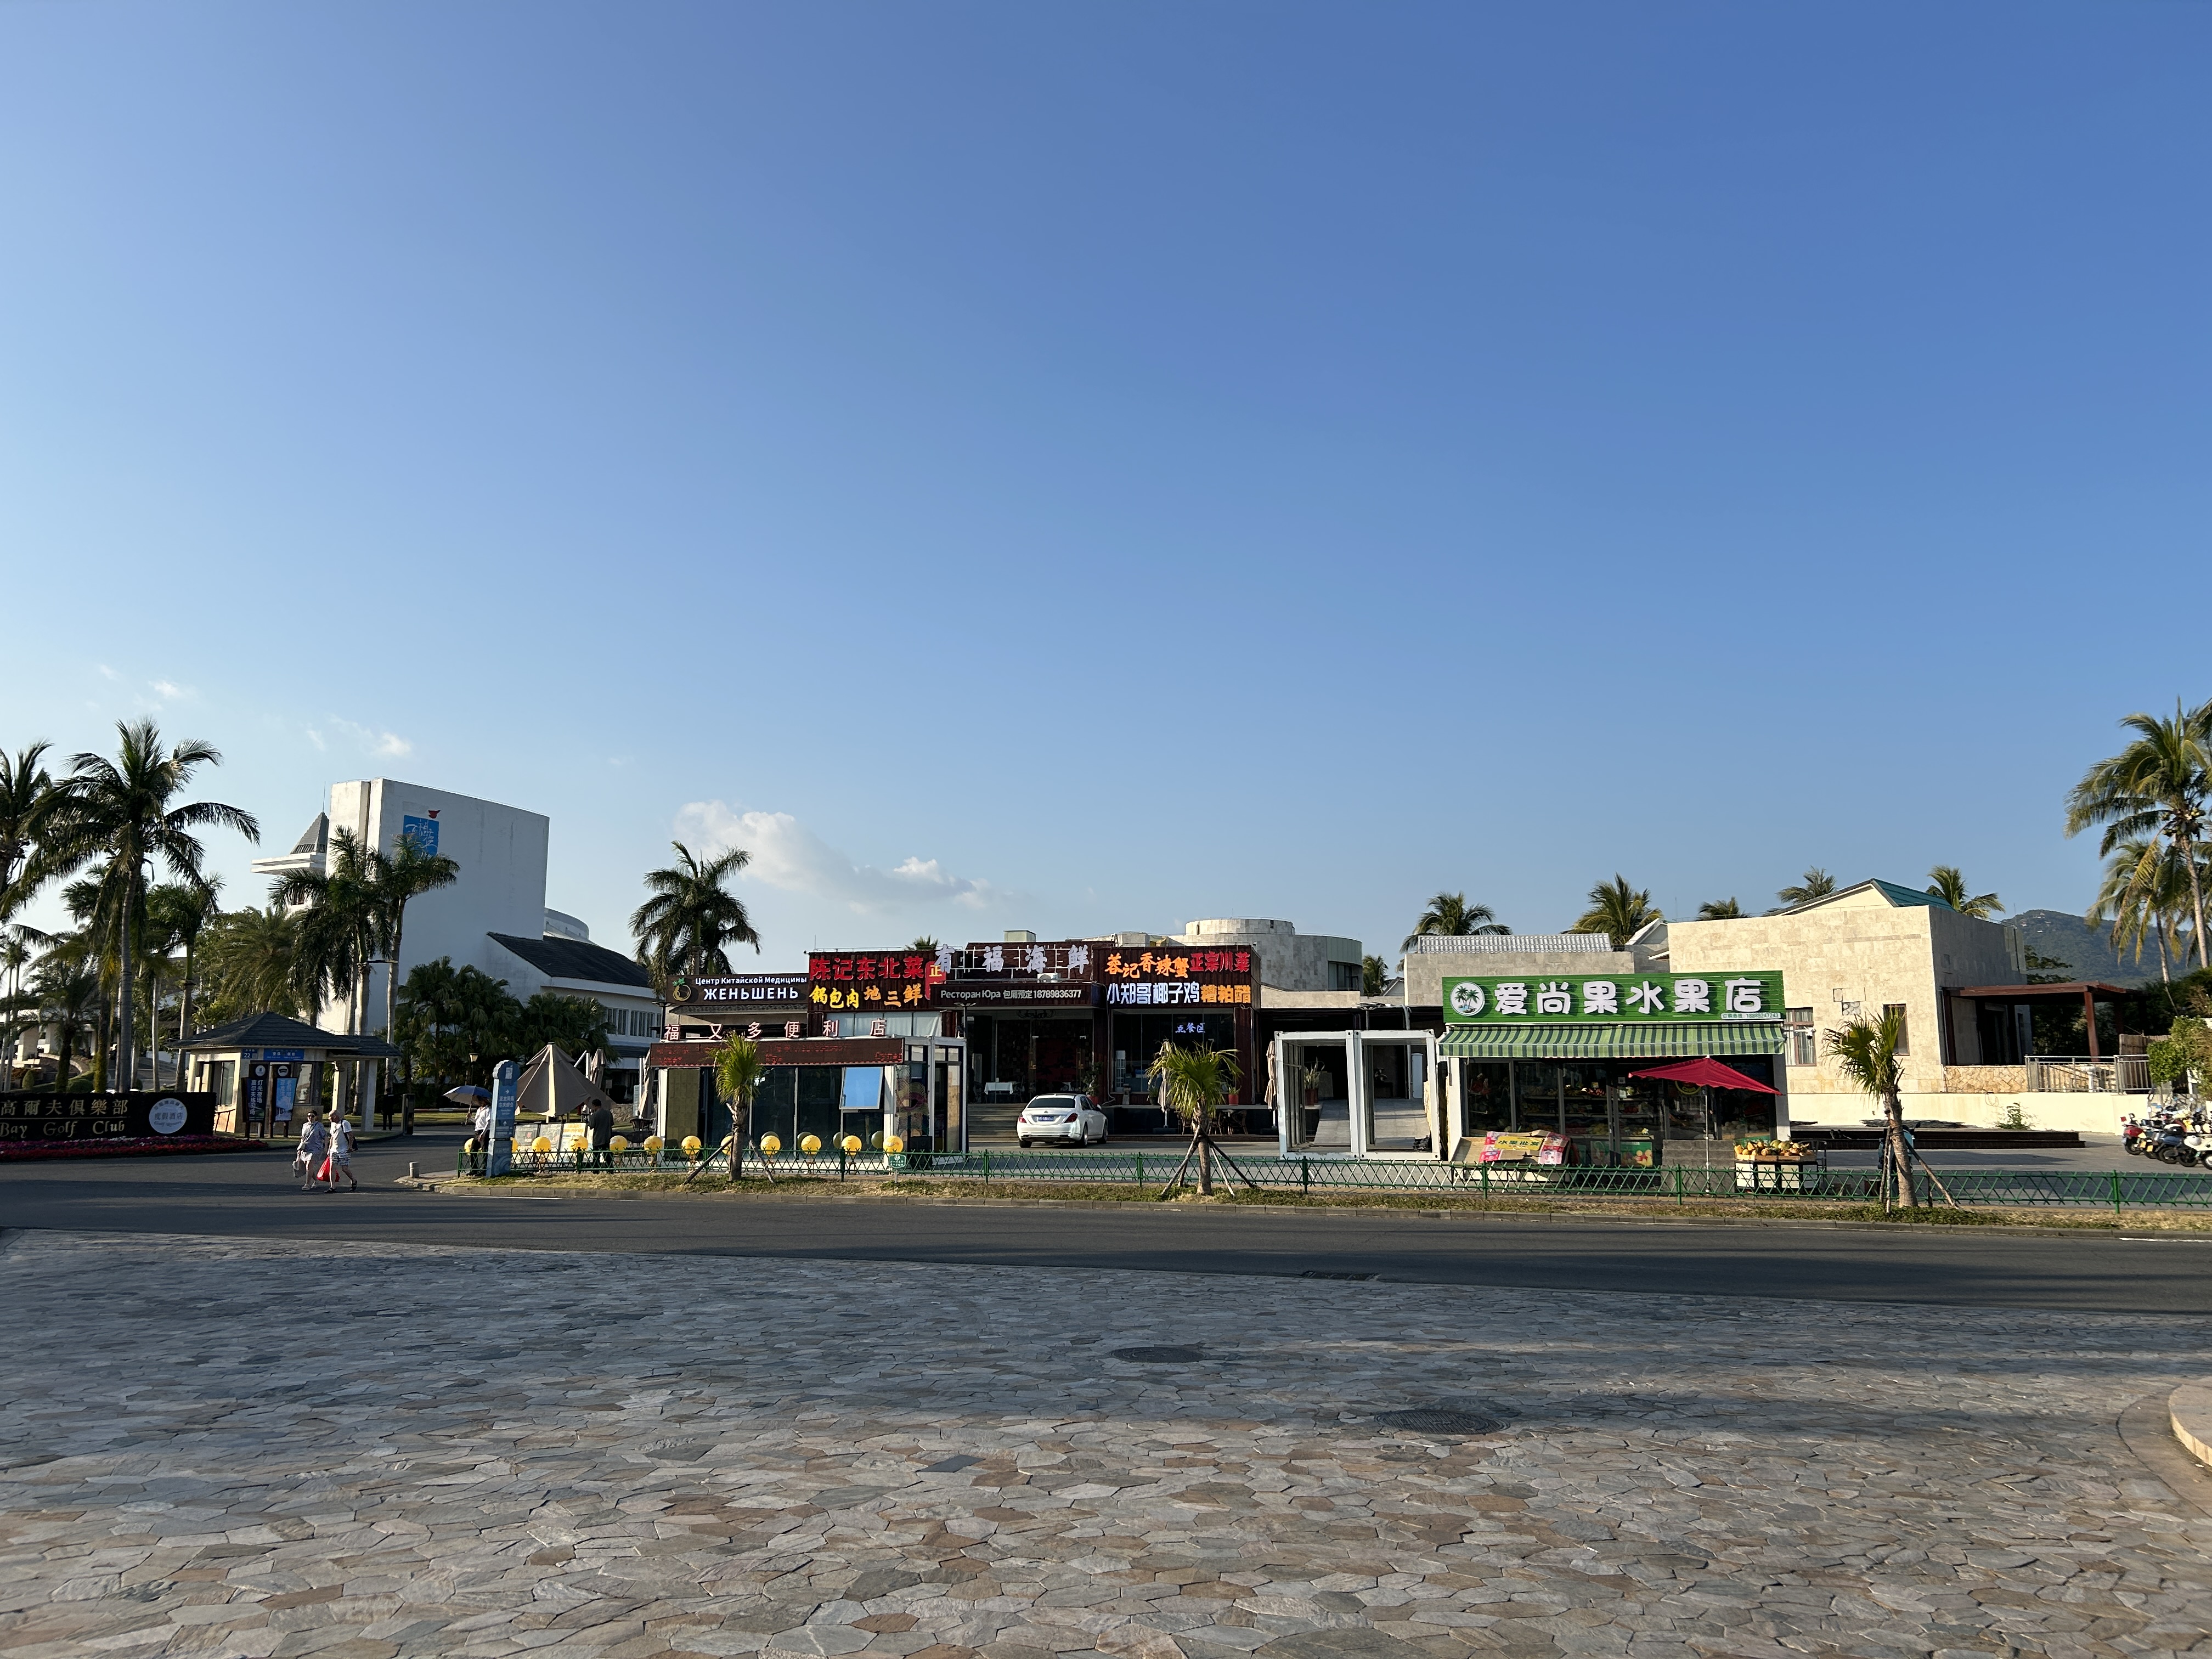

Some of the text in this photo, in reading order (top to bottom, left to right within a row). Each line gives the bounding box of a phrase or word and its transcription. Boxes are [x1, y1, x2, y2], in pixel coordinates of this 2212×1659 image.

[809, 956, 924, 980] 陈记东北菜
[934, 944, 1090, 974] 有福海鲜
[1104, 951, 1250, 979] 蓉记香辣蟹 正宗川菜
[696, 978, 720, 986] Центр
[721, 976, 763, 984] Китайской
[703, 988, 798, 1000] ЖЕНЬШЕНЬ
[809, 983, 923, 1008] 锅包肉 地三鲜
[940, 990, 981, 1000] Ресторан
[981, 990, 1001, 1000] Юра
[1033, 989, 1082, 998] 18789836377
[1107, 981, 1251, 1005] 小郑哥椰子鸡 糟粕醋
[1494, 978, 1762, 1014] 爱尚果水果店
[664, 1019, 886, 1040] 福又多便利店
[1175, 1022, 1206, 1034] 点餐区
[1, 1099, 128, 1116] 高爾夫俱樂部
[0, 1120, 125, 1139] Bay Golf Club
